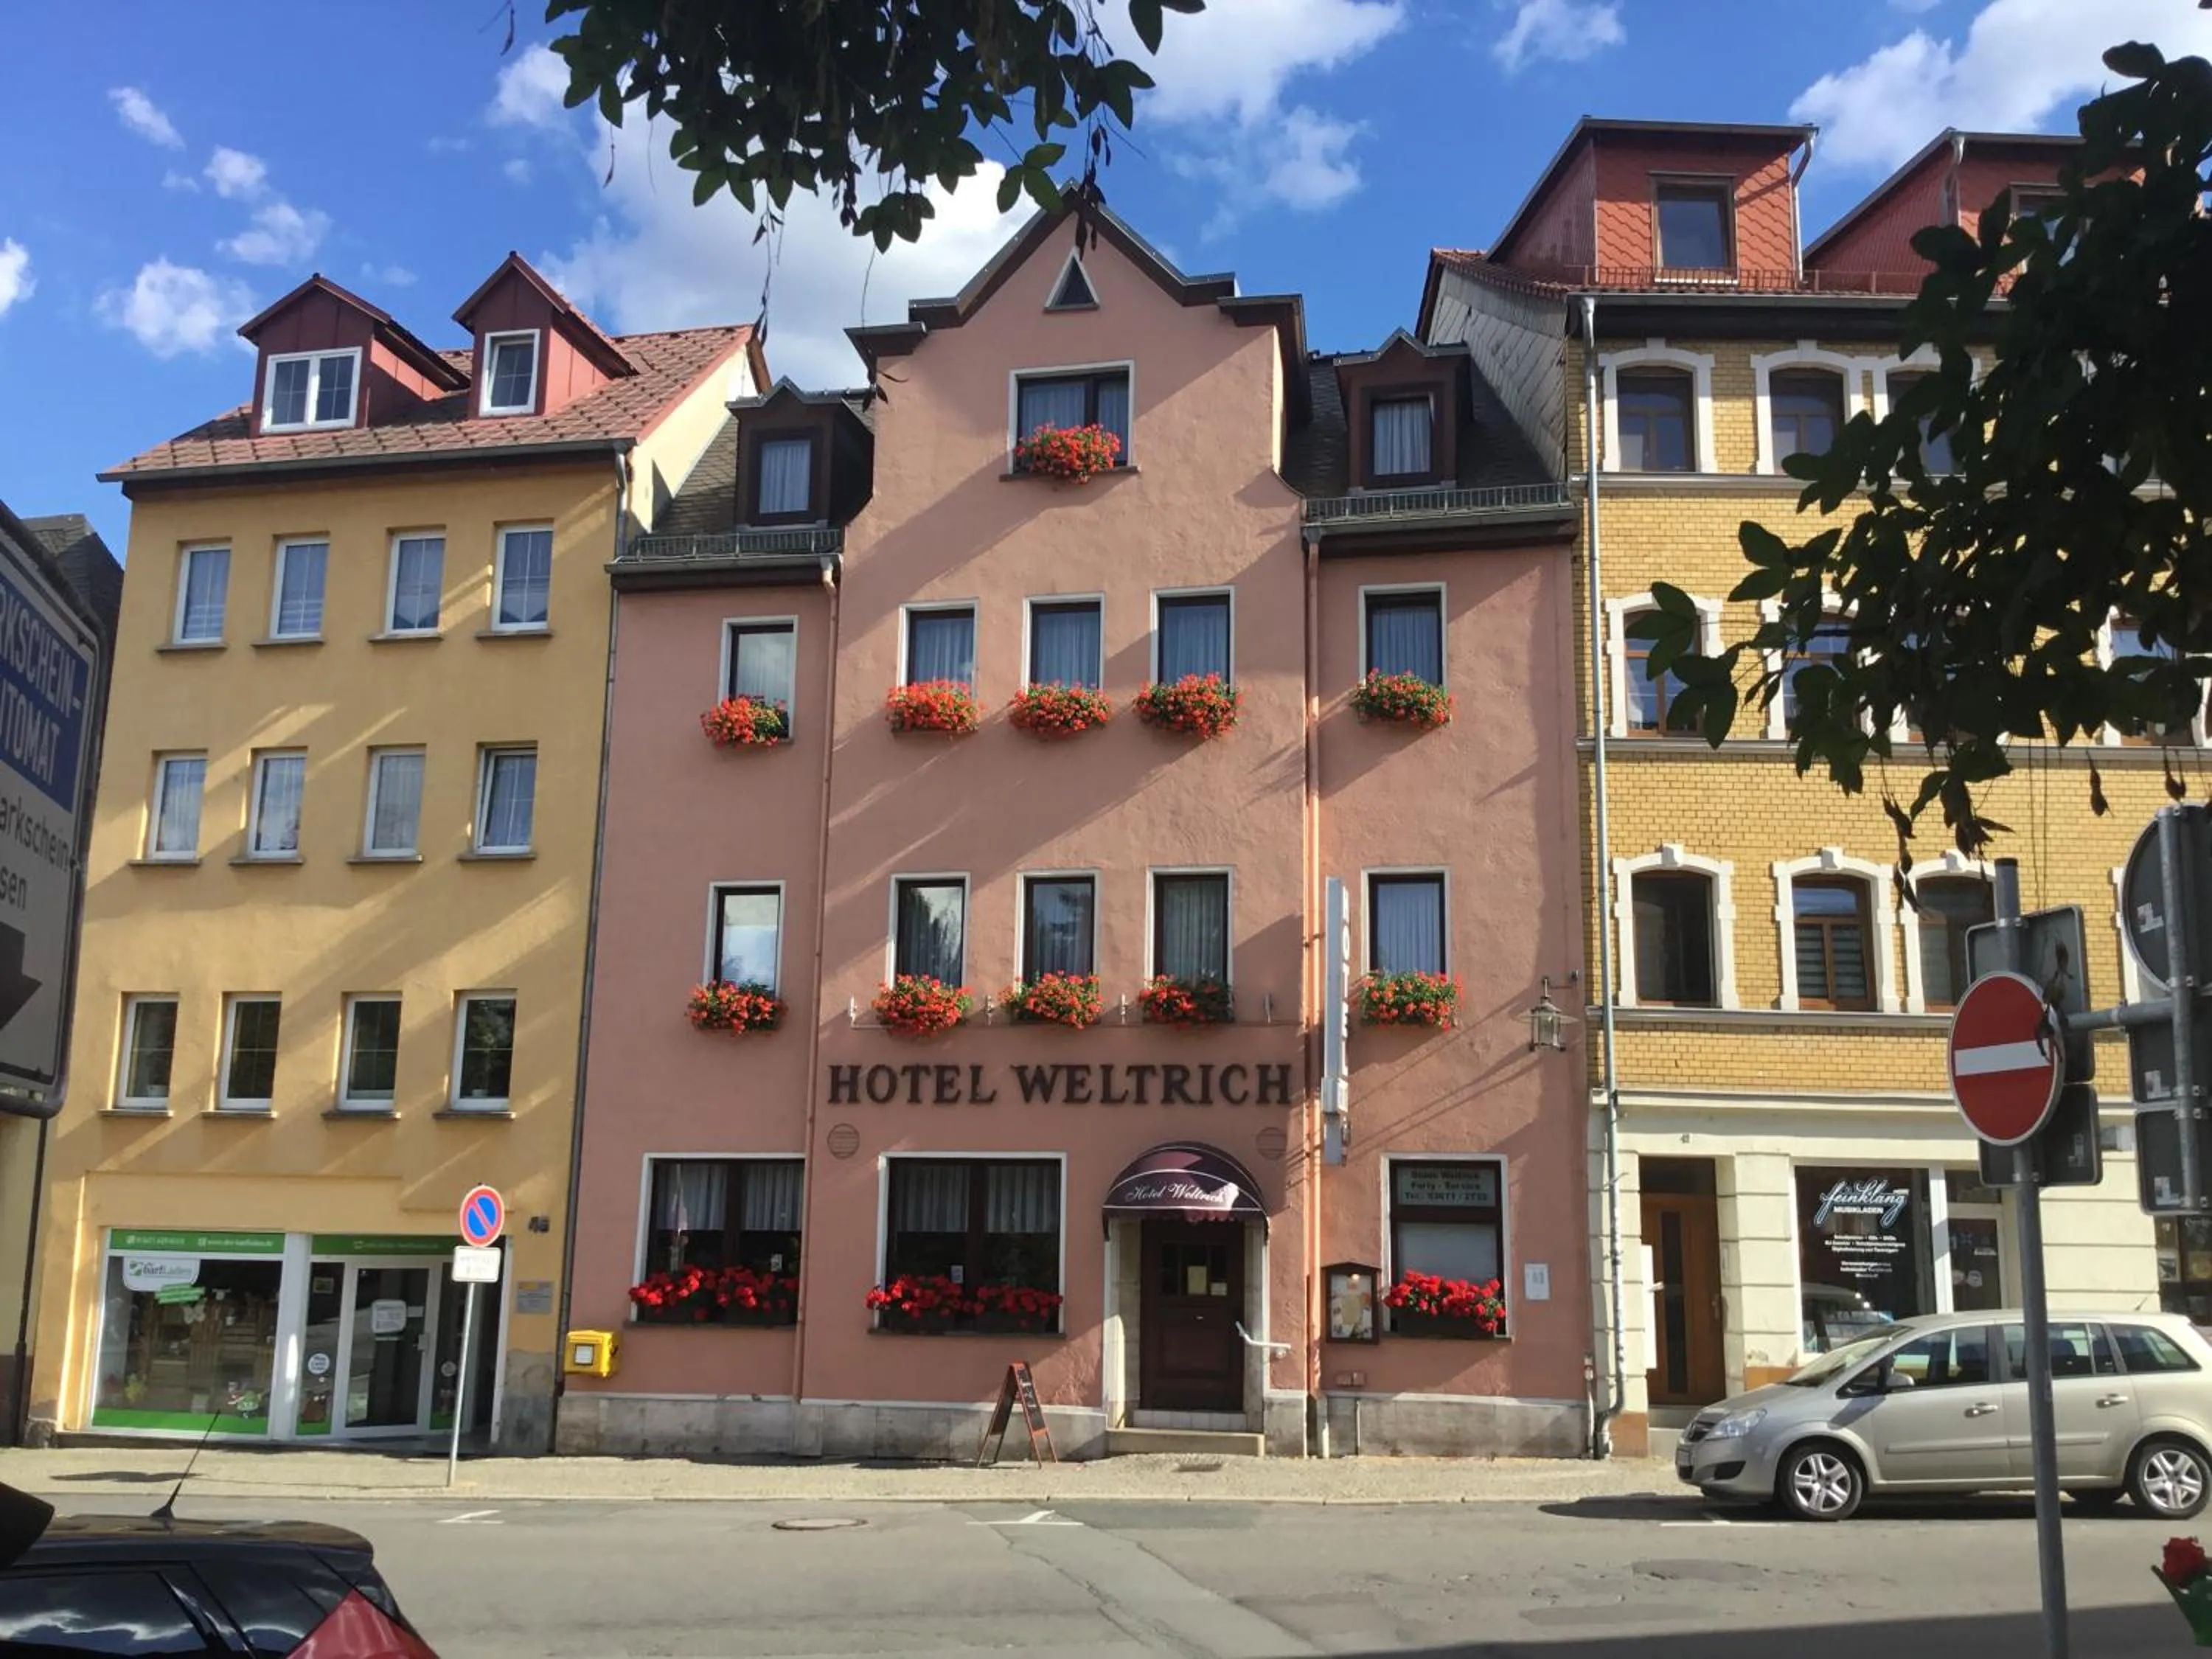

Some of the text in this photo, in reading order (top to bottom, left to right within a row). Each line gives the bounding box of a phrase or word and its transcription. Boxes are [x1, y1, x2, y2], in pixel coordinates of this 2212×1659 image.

[827, 1064, 996, 1105] HOTEL
[1010, 1063, 1292, 1105] WELTRICH
[1125, 1185, 1166, 1203] Hotel
[1814, 1179, 1907, 1228] feinklang
